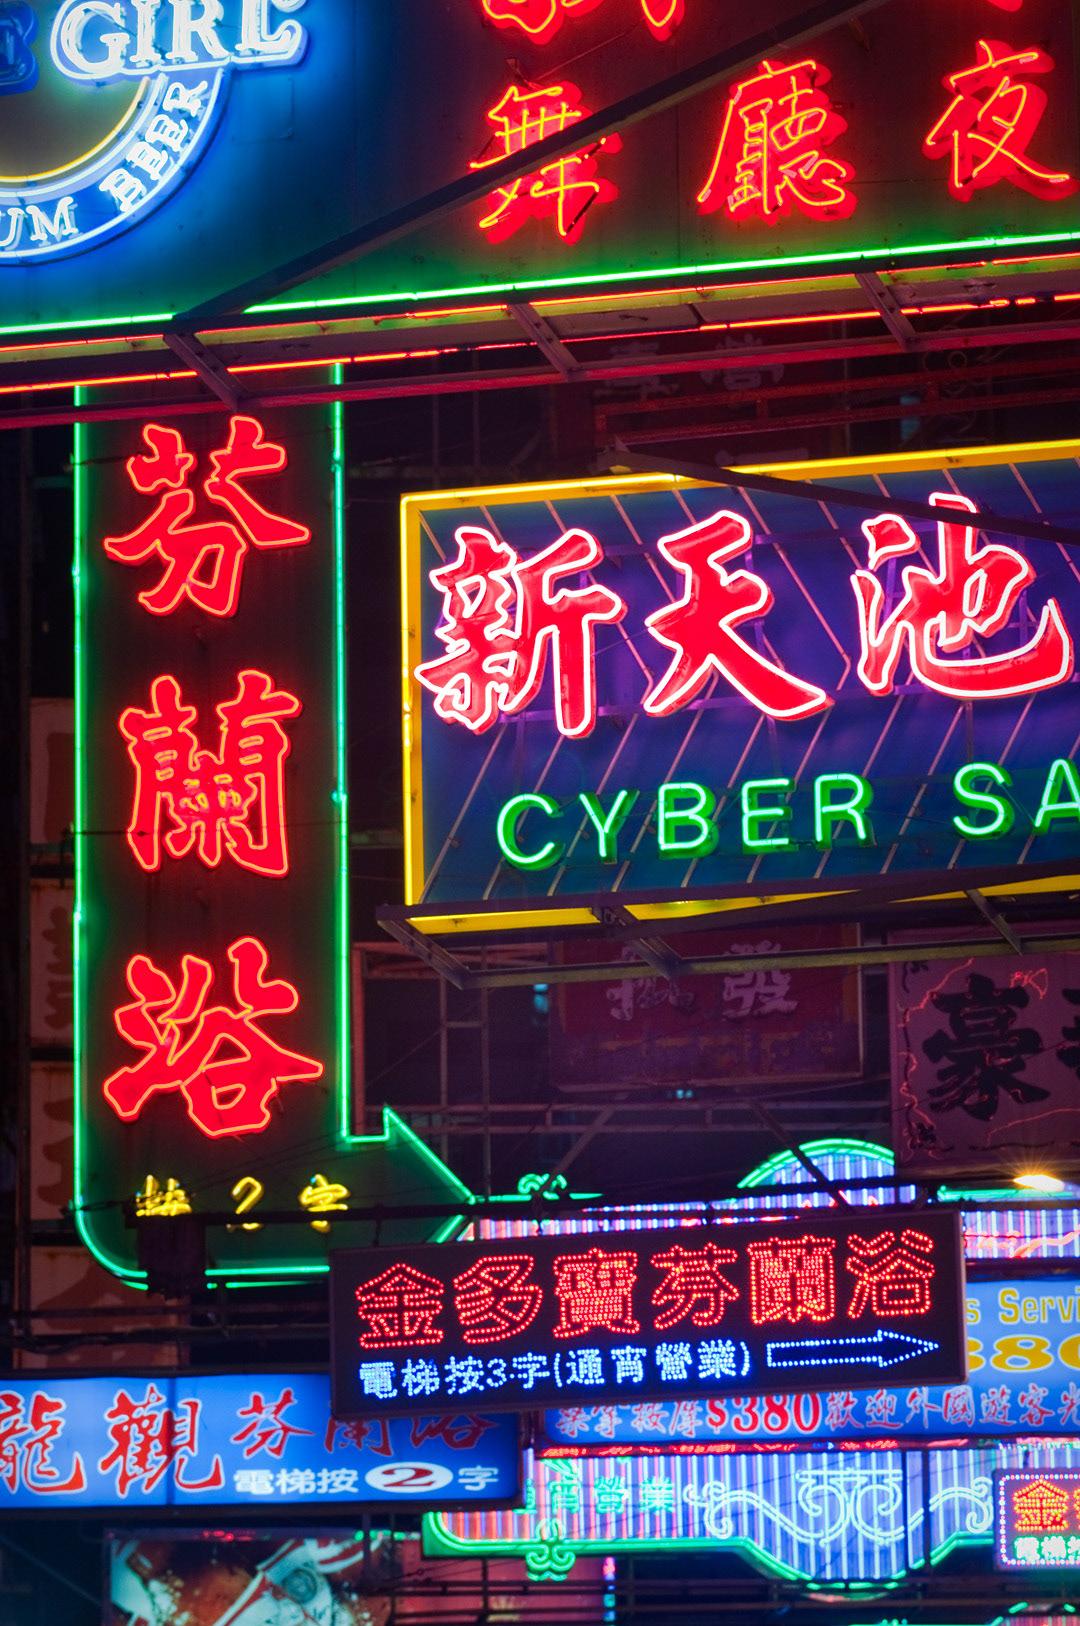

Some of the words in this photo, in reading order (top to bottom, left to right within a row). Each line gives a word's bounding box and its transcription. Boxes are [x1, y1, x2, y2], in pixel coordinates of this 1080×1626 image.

[60, 0, 296, 74] GIRL
[99, 81, 208, 213] BEER
[414, 491, 1074, 739] 新天池
[103, 414, 325, 1139] 芬蘭浴
[496, 770, 871, 868] CYBER
[922, 972, 1080, 1121] 豪
